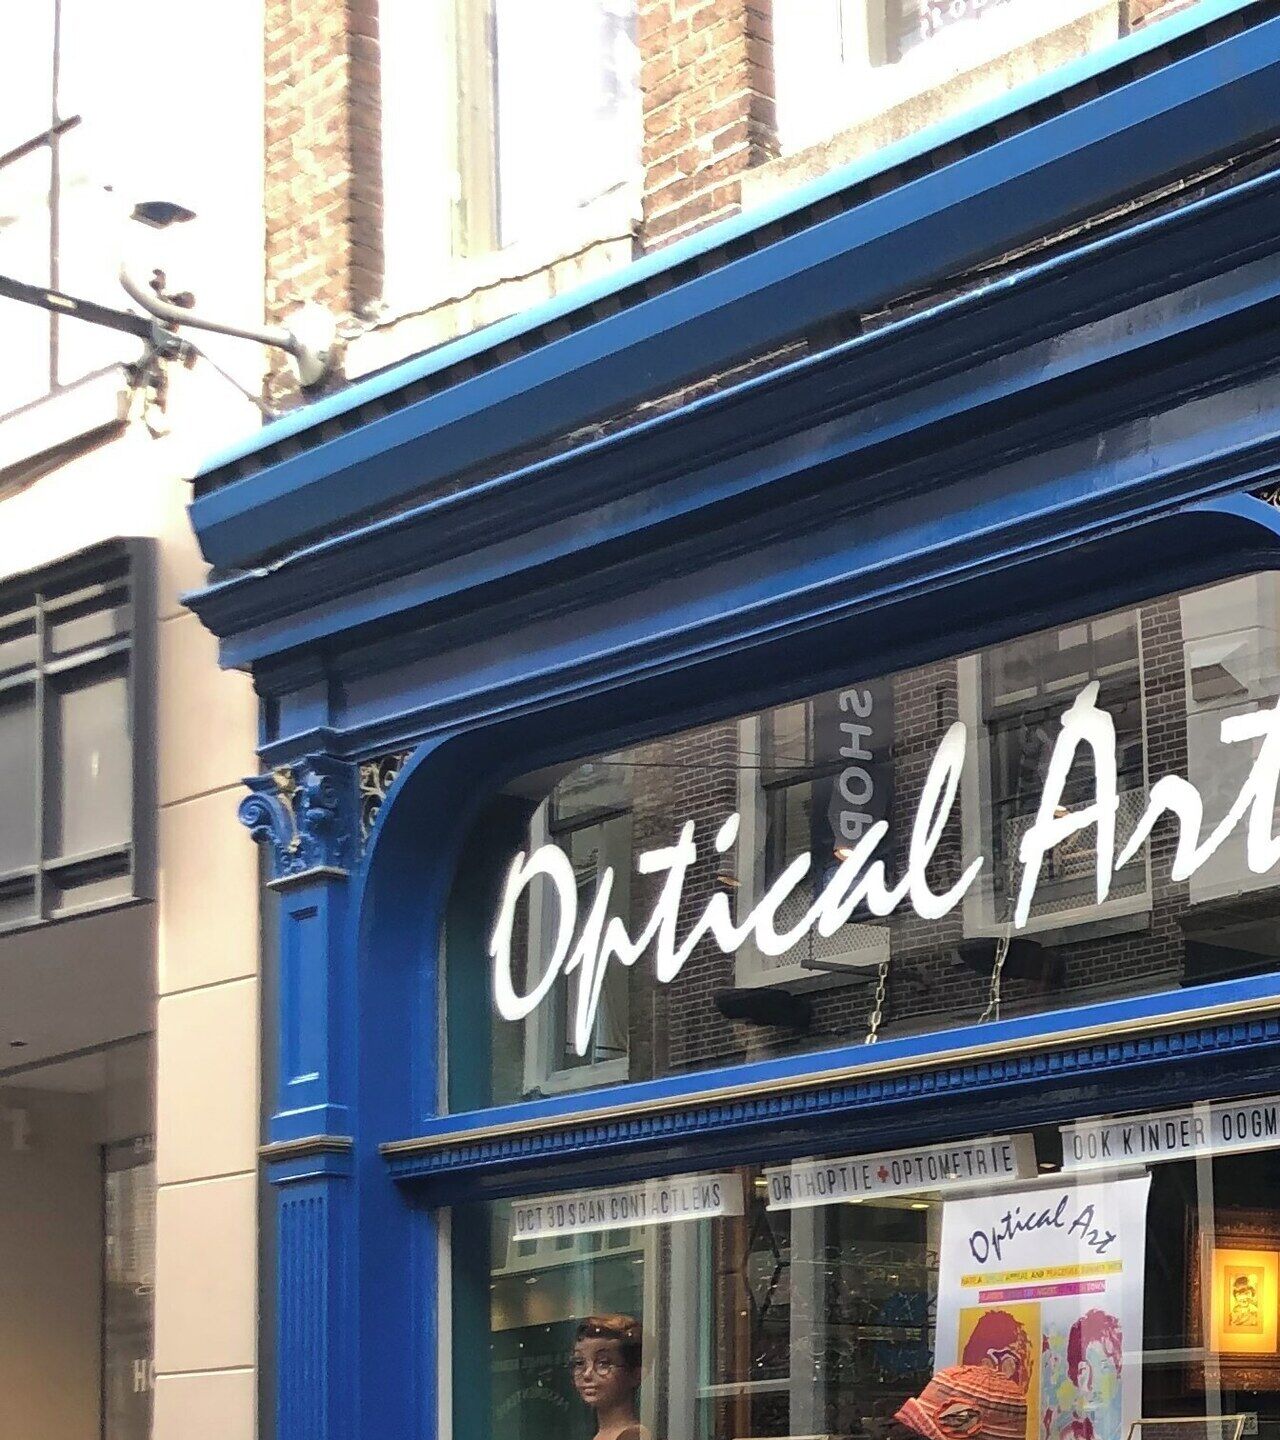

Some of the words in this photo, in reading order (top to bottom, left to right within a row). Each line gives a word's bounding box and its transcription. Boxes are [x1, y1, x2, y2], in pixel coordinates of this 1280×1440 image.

[489, 721, 985, 1057] Optical
[1073, 1129, 1112, 1161] OOK
[1122, 1116, 1205, 1156] KINDER
[772, 1165, 873, 1202] ORTHOPTIE
[891, 1145, 1013, 1186] OPTOMETRIE
[969, 1194, 1069, 1264] Optical
[1067, 1204, 1117, 1254] Art
